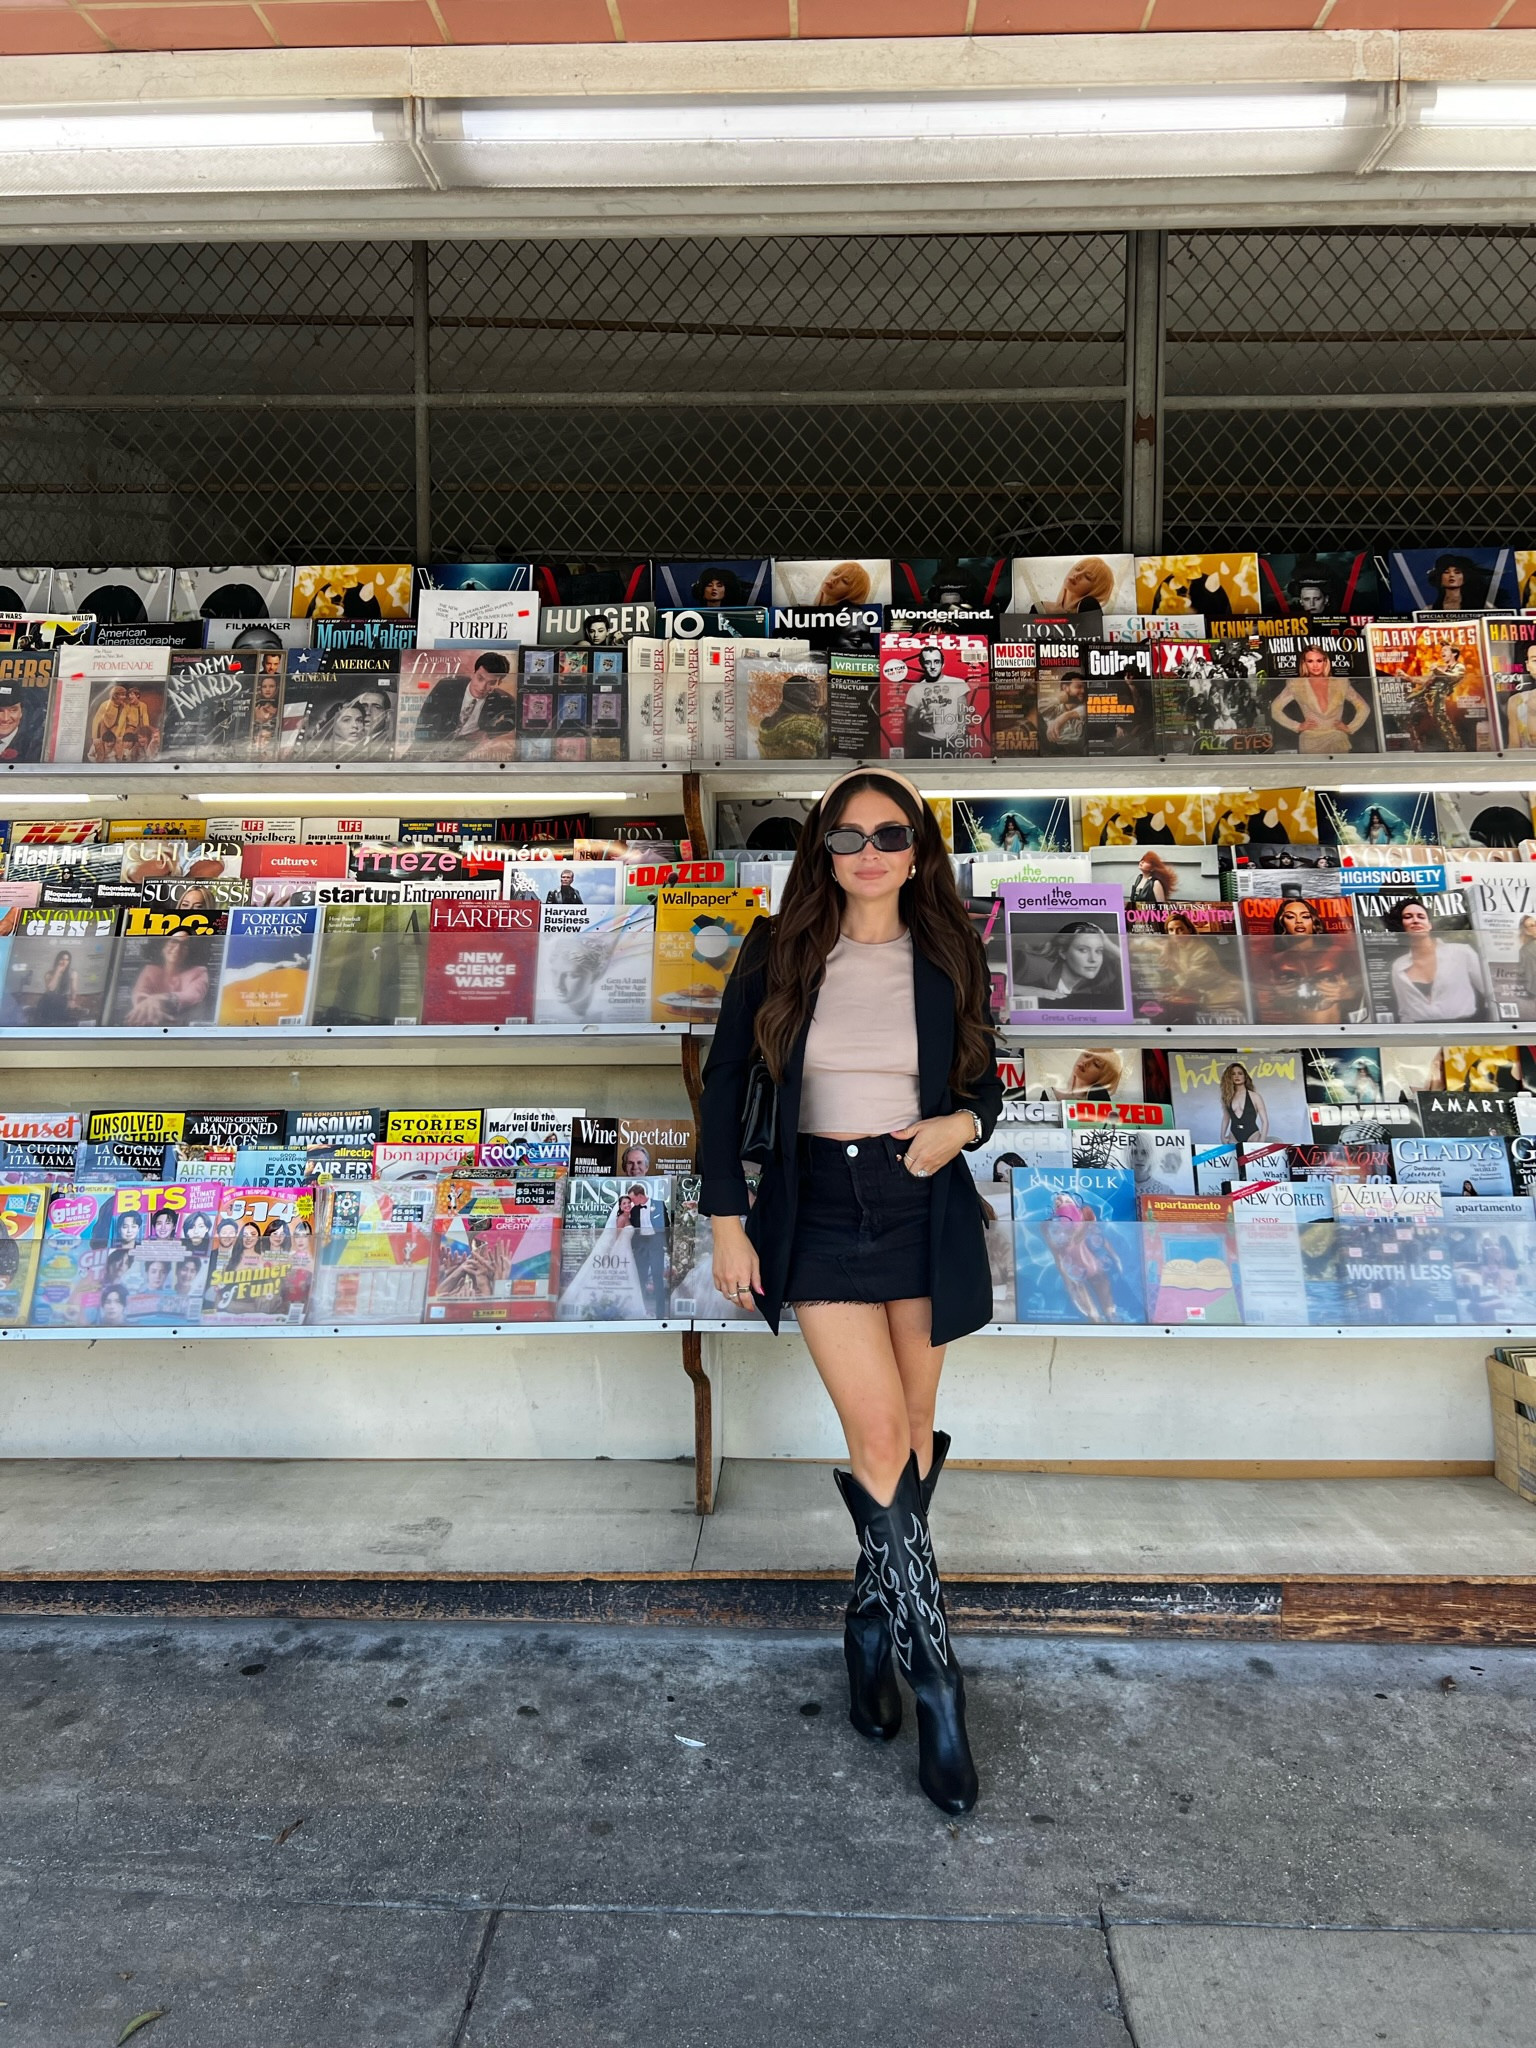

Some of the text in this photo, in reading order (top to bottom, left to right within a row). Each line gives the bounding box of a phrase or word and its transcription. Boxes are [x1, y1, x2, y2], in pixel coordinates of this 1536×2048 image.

[774, 606, 879, 629] Numéro
[890, 608, 994, 620] Wonderland.
[226, 622, 290, 630] FILMMAKER
[450, 621, 508, 639] PURPLE
[661, 610, 704, 638] 10
[1127, 617, 1180, 631] Gloria
[1211, 620, 1255, 638] KENNY
[1258, 616, 1310, 638] ROGERS
[98, 628, 146, 637] American
[316, 624, 417, 650] MovieMaker
[1022, 624, 1080, 638] TONY
[1110, 630, 1198, 643] ESTEFAN
[1372, 626, 1476, 646] HARRY STYLES
[1490, 624, 1536, 641] HARRY
[97, 636, 186, 646] Cinematographer
[881, 634, 988, 650] faith
[996, 646, 1035, 658] MUSIC
[1039, 644, 1080, 658] MUSIC
[996, 658, 1036, 667] CONNECTION
[1040, 658, 1080, 667] CONNECTION
[1276, 654, 1297, 662] FROM
[92, 661, 153, 670] PROMENADE
[332, 659, 390, 670] AMERICAN
[835, 661, 880, 673] WRITER'S
[1380, 682, 1412, 692] HARRY'S
[1088, 696, 1118, 704] JAKE
[1382, 693, 1406, 704] HOUSE
[958, 704, 976, 714] The
[1088, 705, 1135, 714] KISZKA
[933, 711, 983, 724] House
[946, 732, 983, 748] Keith
[243, 822, 263, 830] LIFE
[338, 822, 362, 832] LIFE
[436, 822, 458, 832] LIFE
[502, 819, 586, 840] MARILYN
[208, 833, 243, 842] Steven
[244, 832, 296, 844] Spielberg
[614, 828, 666, 840] TONY
[126, 842, 242, 862] CULTURED
[466, 844, 552, 861] Numéro
[580, 852, 598, 860] NEW
[354, 847, 457, 872] frieze
[637, 862, 725, 886] DAZED
[1023, 864, 1042, 876] the
[1340, 869, 1442, 884] HIGHSNOBIETY
[44, 890, 82, 898] Bloomberg
[318, 886, 400, 905] startup
[404, 884, 497, 902] Entrepreneur
[1052, 886, 1072, 898] the
[44, 896, 92, 904] Businessweek
[1018, 896, 1106, 909] gentlewoman
[433, 907, 532, 928] HARPER'S
[544, 908, 588, 916] Harvard
[126, 908, 215, 936] Inc.
[241, 914, 308, 925] FOREIGN
[544, 916, 590, 924] Business
[245, 926, 302, 938] AFFAIRS
[544, 924, 581, 933] Review
[444, 964, 516, 976] SCIENCE
[456, 976, 504, 988] WARS
[1042, 1014, 1097, 1023] Greta Gerwig
[514, 1112, 556, 1120] Inside the
[1076, 1102, 1163, 1126] DAZED
[1320, 1104, 1411, 1126] DAZED
[94, 1114, 164, 1135] UNSOLVED
[189, 1122, 278, 1135] ABANDONED
[296, 1116, 372, 1134] UNSOLVED
[391, 1119, 478, 1130] STORIES
[489, 1121, 572, 1132] Marvel Univers
[580, 1119, 690, 1147] Wine Spectator
[209, 1134, 258, 1146] PLACES
[402, 1135, 464, 1144] SONGS
[1080, 1135, 1185, 1147] DAPPER DAN
[382, 1148, 413, 1161] bon
[1396, 1140, 1504, 1163] GLADYS
[10, 1155, 74, 1166] ITALIANA
[97, 1156, 162, 1166] ITALIANA
[575, 1158, 598, 1166] ANNUAL
[265, 1164, 306, 1176] EASY
[575, 1166, 612, 1174] RESTAURANT
[1030, 1174, 1119, 1189] KINFOLK
[118, 1187, 188, 1214] BTS
[190, 1202, 214, 1210] FANBOOK
[1240, 1194, 1326, 1206] NEW YORKER
[220, 1200, 297, 1223] J-14
[567, 1202, 614, 1214] weddings
[1154, 1201, 1221, 1212] apartamento
[1455, 1204, 1522, 1213] apartamento
[592, 1255, 630, 1268] 800+
[211, 1264, 291, 1286] Summer
[1346, 1264, 1452, 1280] WORTH LESS
